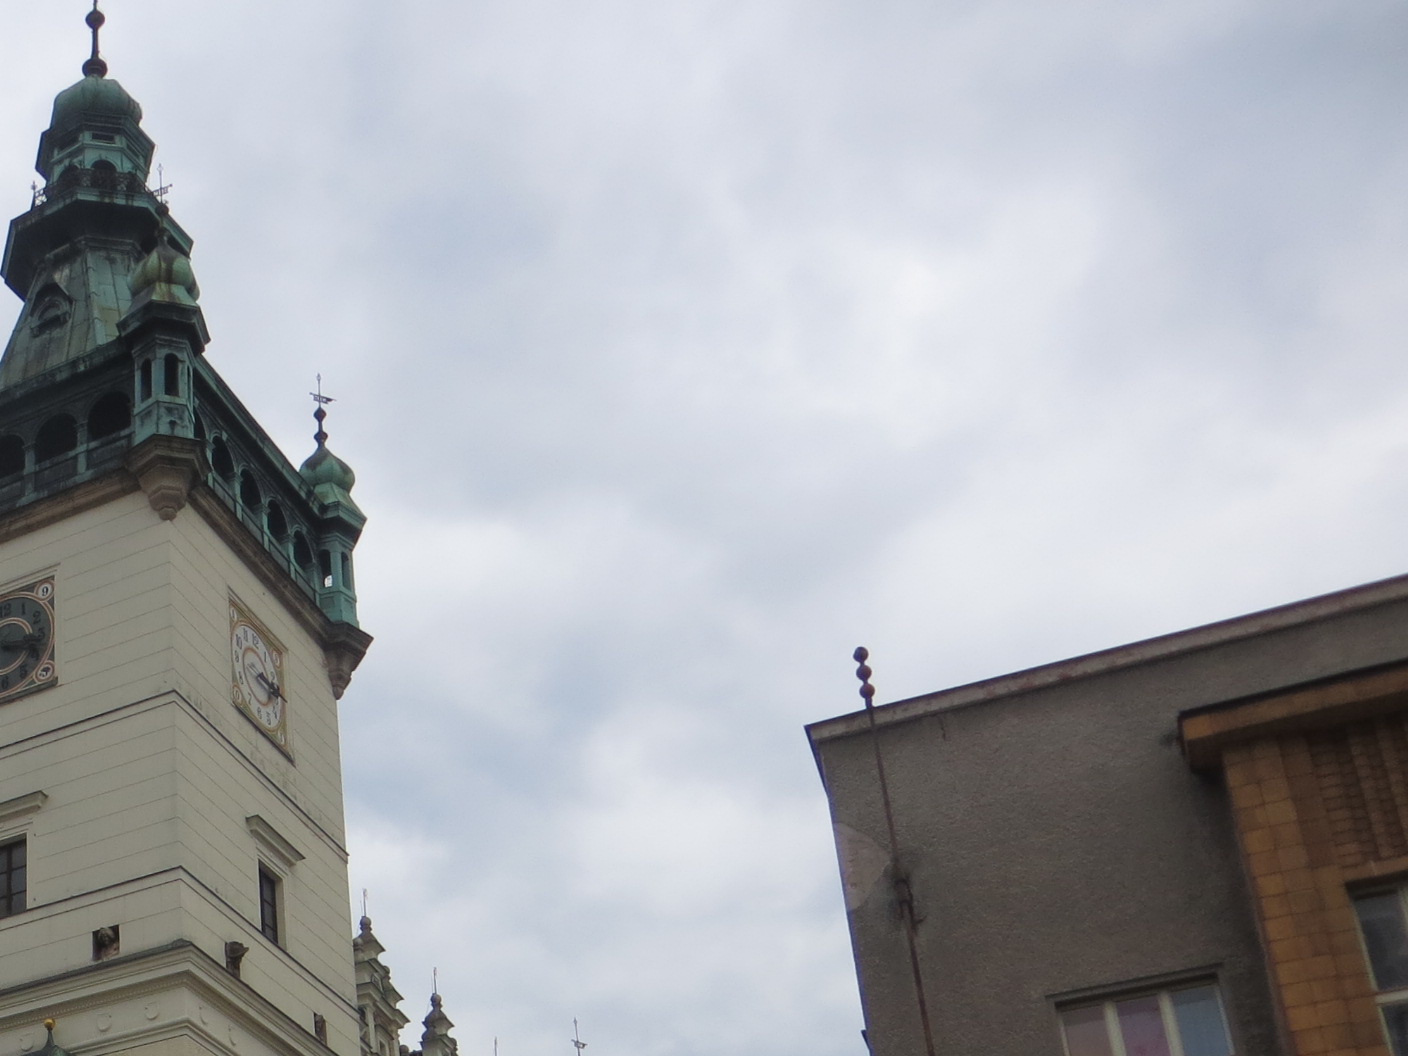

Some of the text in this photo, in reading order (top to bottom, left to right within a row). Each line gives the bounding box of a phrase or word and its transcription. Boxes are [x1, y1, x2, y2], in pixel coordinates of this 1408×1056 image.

[42, 586, 49, 597] 9
[0, 603, 12, 619] 12
[21, 602, 26, 616] 1
[33, 610, 41, 625] 2
[19, 664, 28, 679] 5
[2, 676, 9, 690] 6
